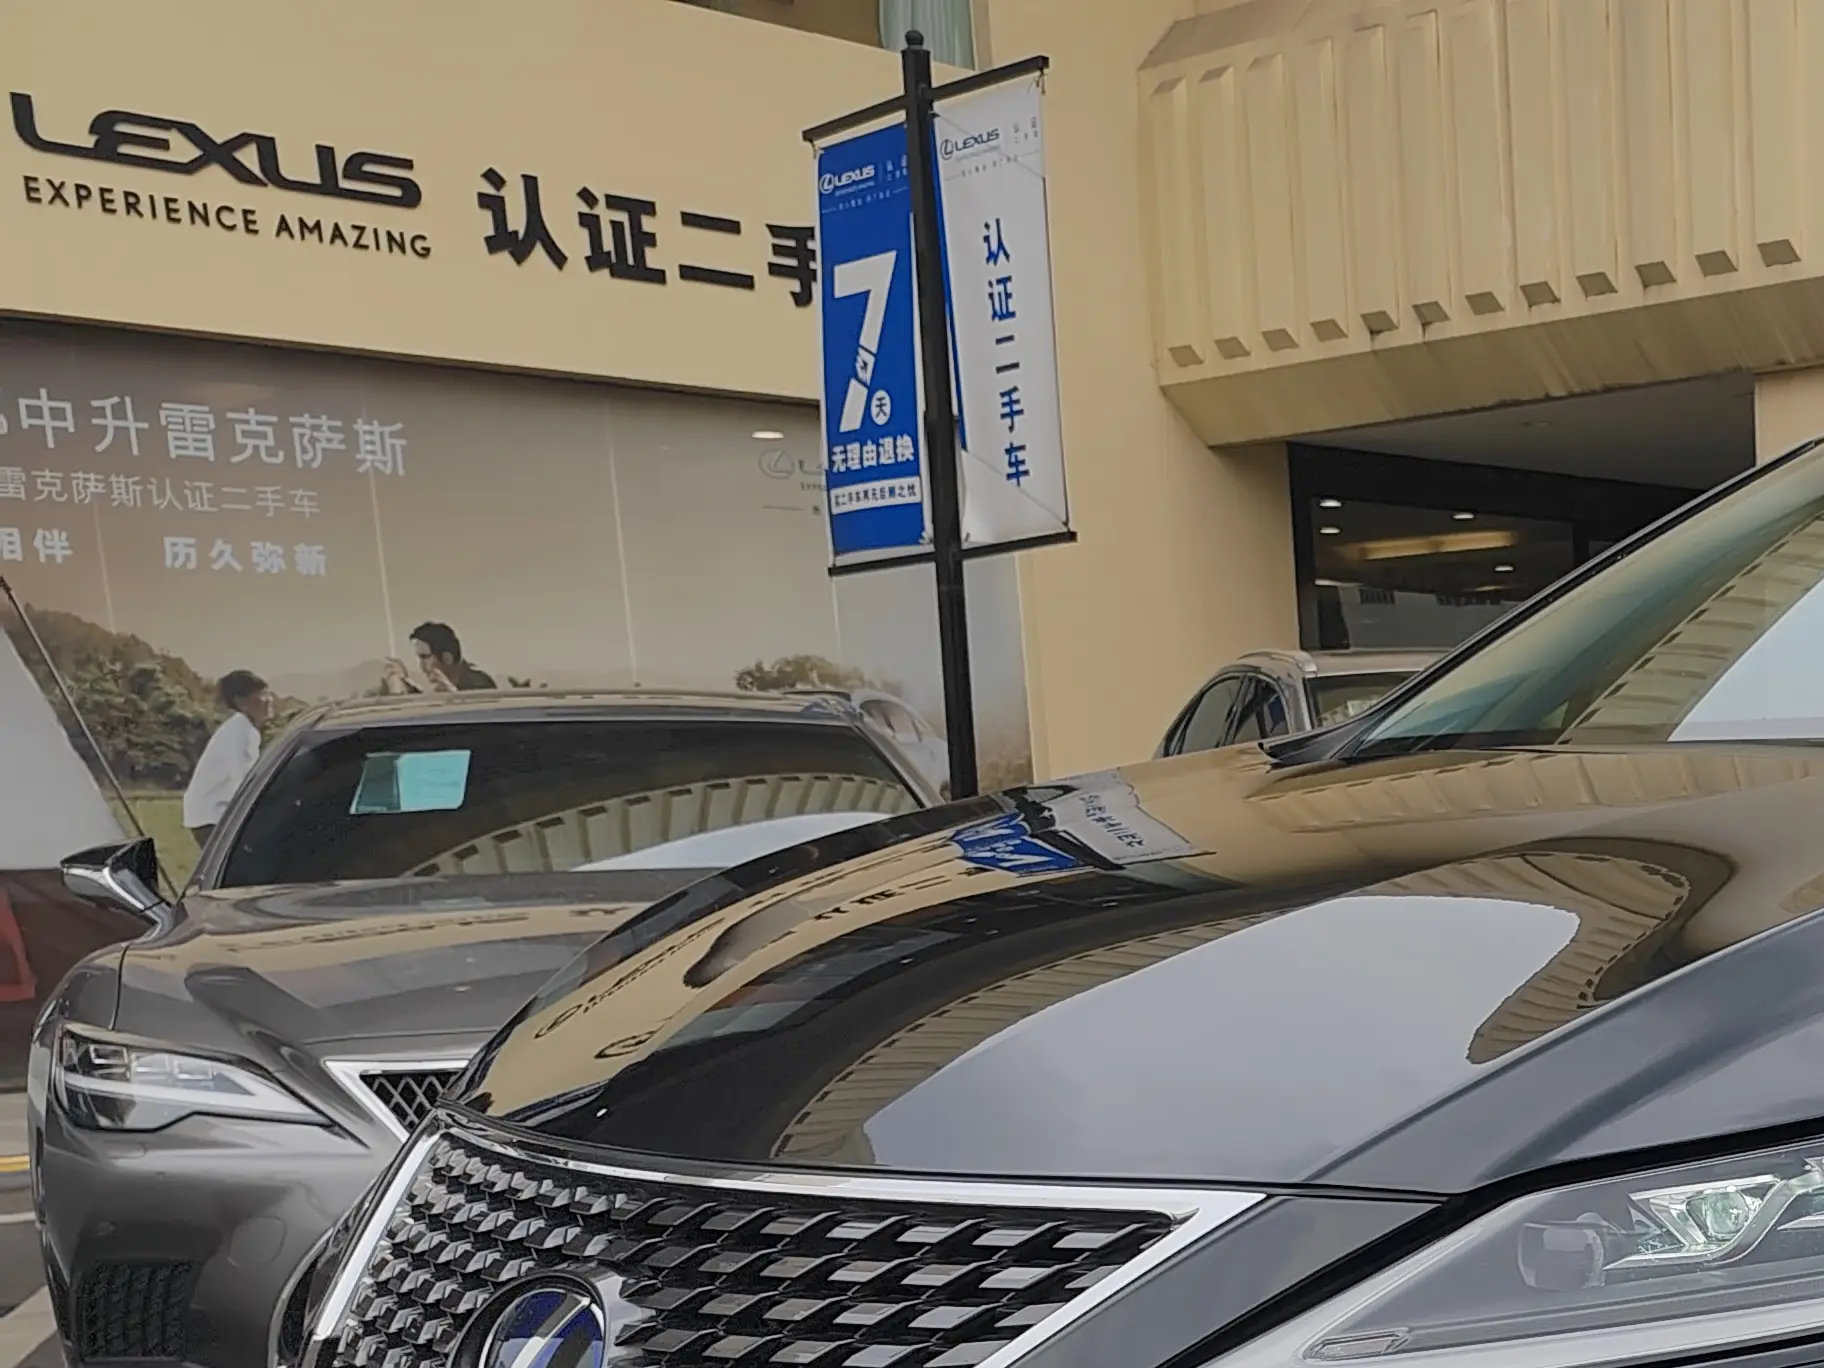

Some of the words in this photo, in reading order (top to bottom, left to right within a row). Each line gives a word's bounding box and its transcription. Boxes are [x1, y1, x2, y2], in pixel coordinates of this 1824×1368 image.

[10, 91, 422, 209] LEXUS
[954, 127, 1000, 152] LEXUS
[834, 164, 875, 187] LEXUS
[23, 175, 260, 235] EXPERIENCE
[274, 214, 432, 259] AMAZING
[476, 166, 818, 308] 认证二手
[982, 217, 1031, 488] 认证二手车
[0, 387, 408, 477] 中升雷克萨斯
[831, 433, 915, 474] 无理由退换
[0, 465, 321, 519] 雷克萨斯认证二手车
[163, 535, 328, 577] 历久弥新
